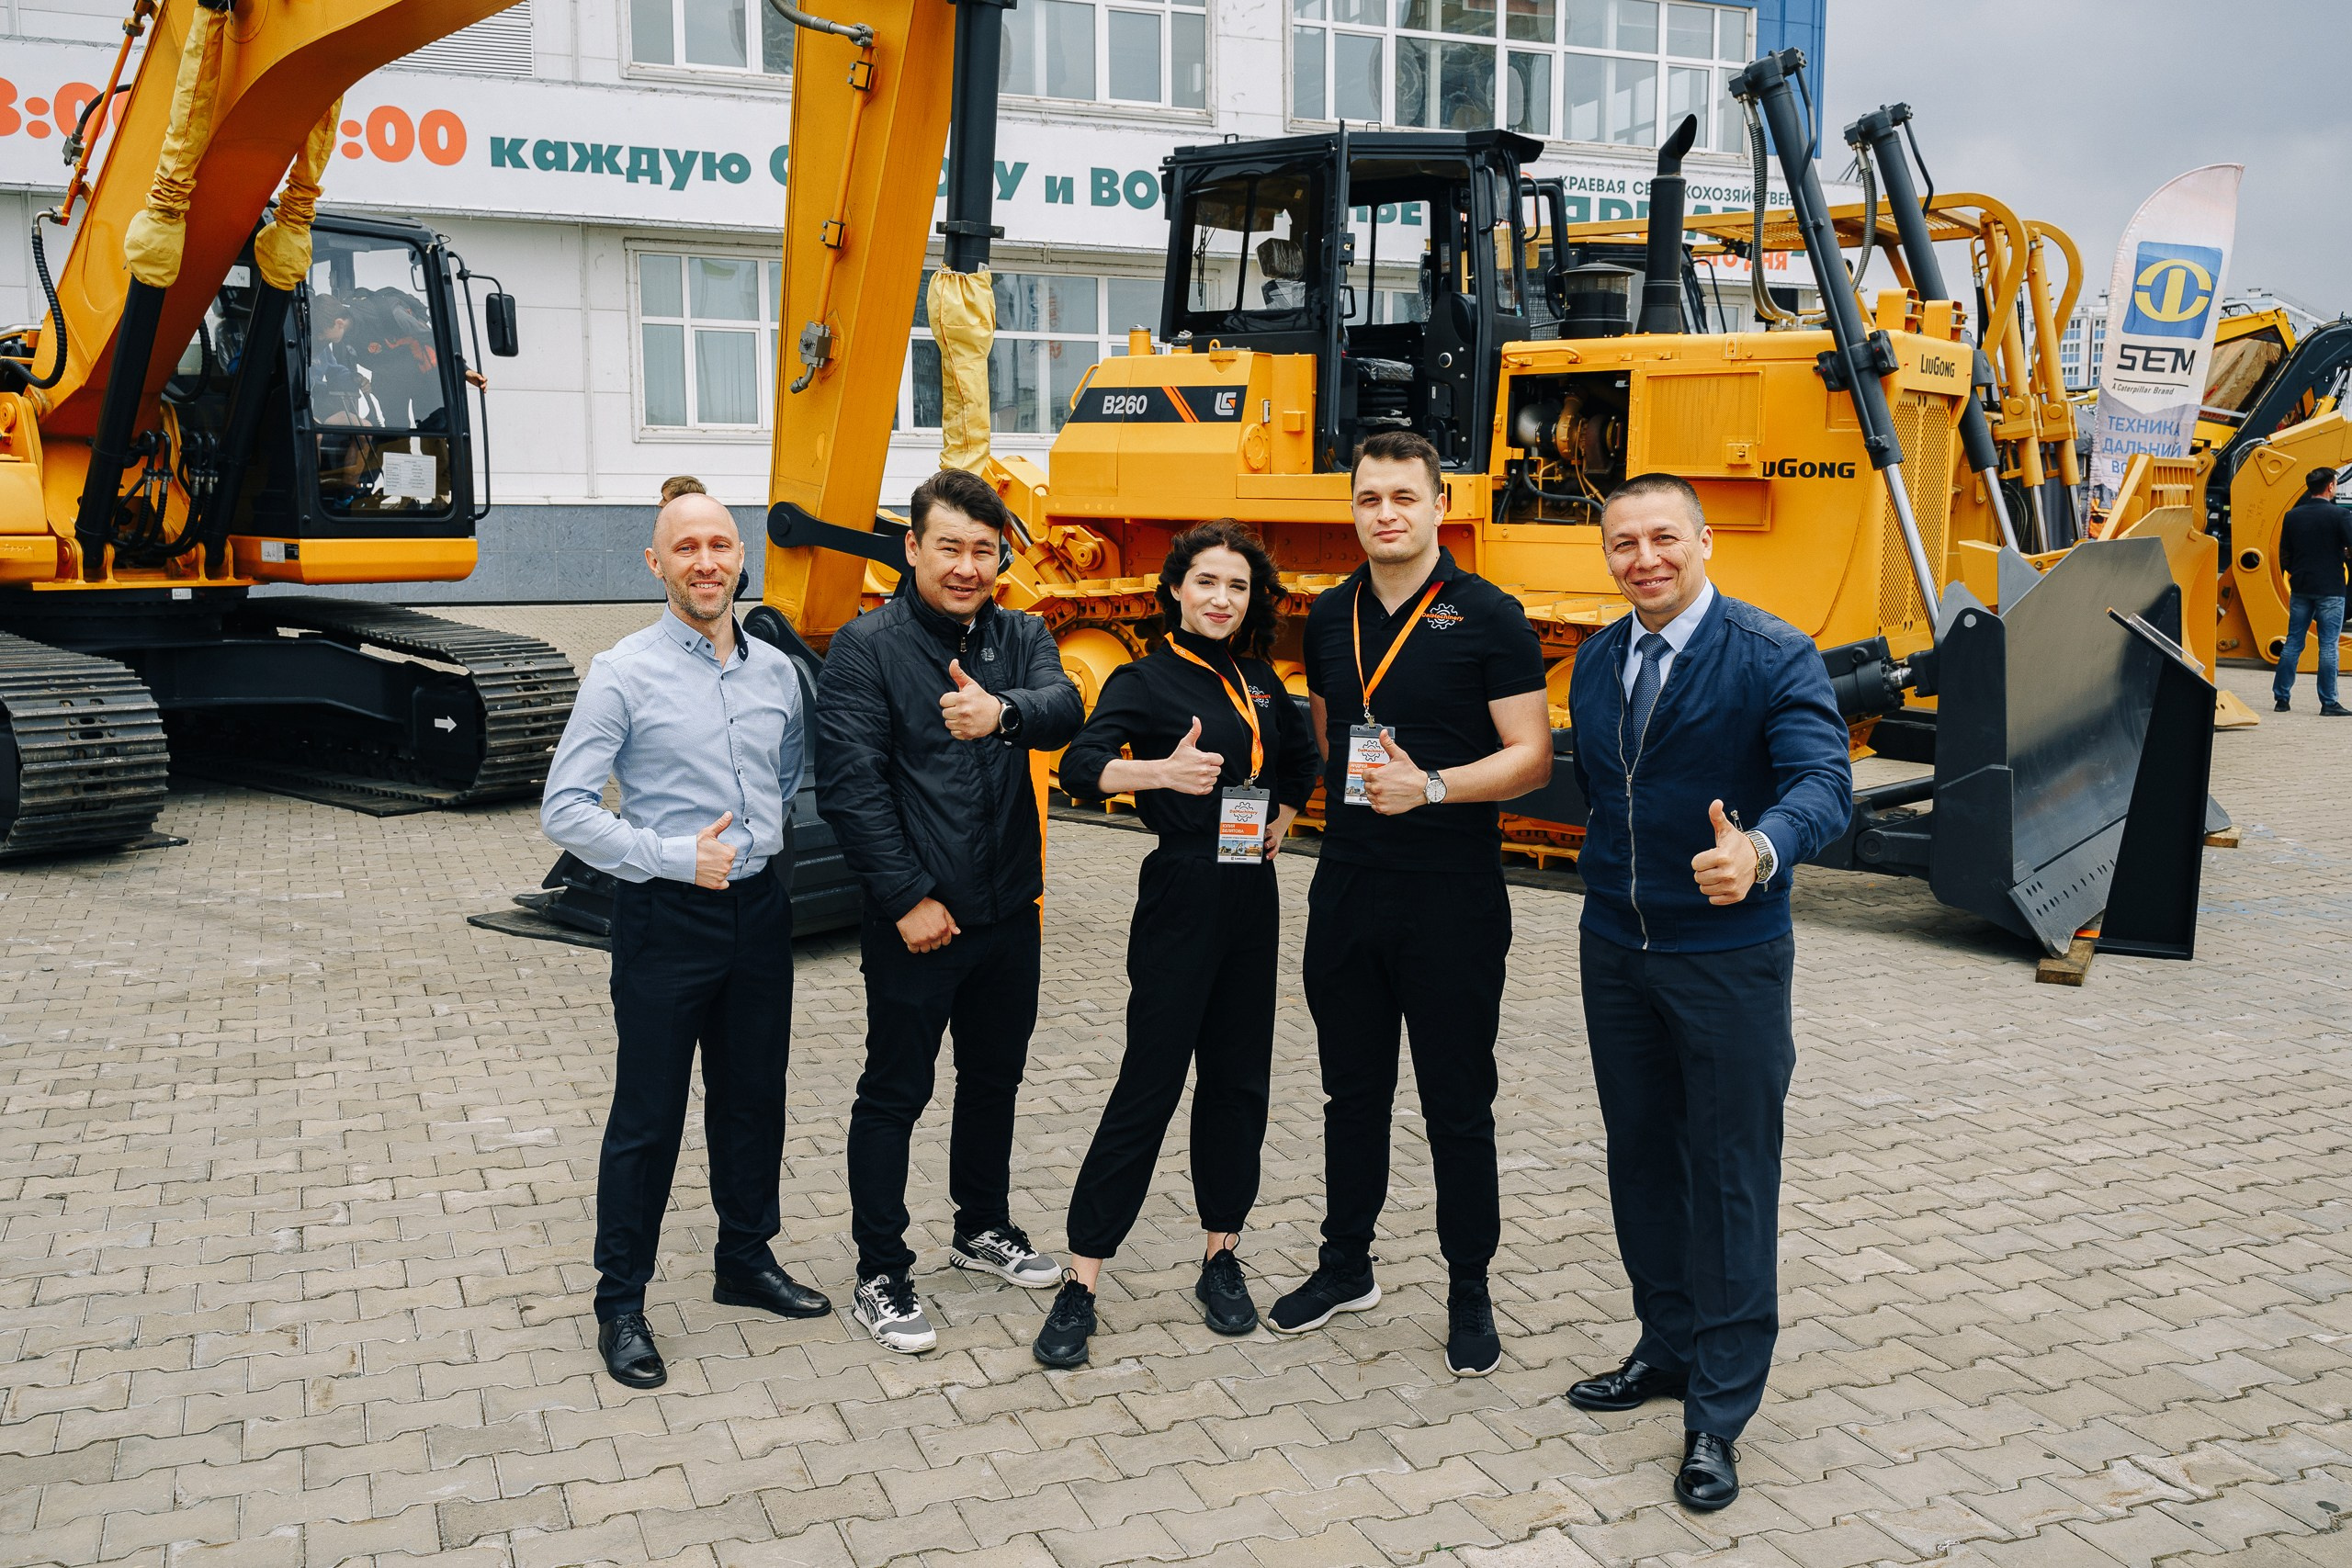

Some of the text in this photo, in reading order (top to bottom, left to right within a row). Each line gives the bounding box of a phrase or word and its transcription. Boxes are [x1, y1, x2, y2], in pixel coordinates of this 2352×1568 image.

[490, 136, 752, 191] каждую
[1045, 175, 1074, 205] и
[2116, 344, 2197, 376] SEM
[2117, 383, 2152, 394] Caterpillar
[2153, 386, 2175, 395] Brand
[1102, 395, 1148, 414] B260
[2109, 415, 2181, 437] ТЕХНИКА
[2102, 437, 2182, 457] ДАЛЬНИЙ
